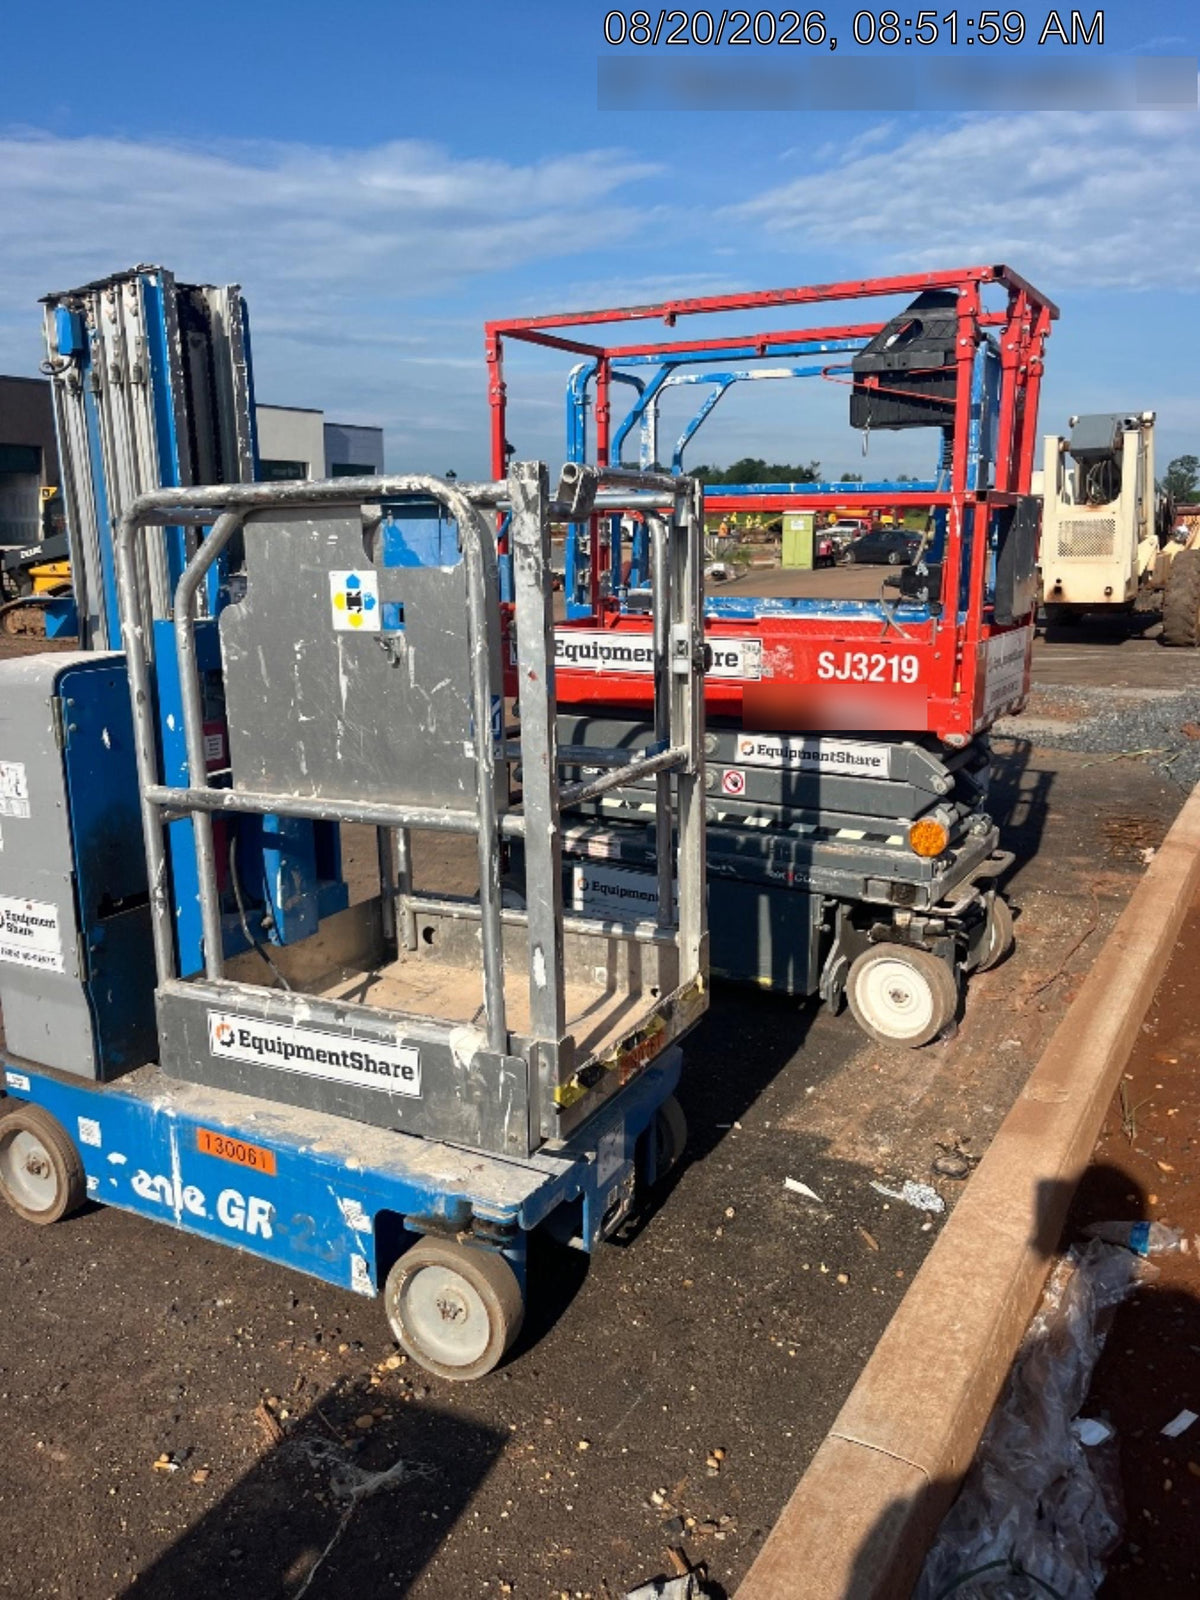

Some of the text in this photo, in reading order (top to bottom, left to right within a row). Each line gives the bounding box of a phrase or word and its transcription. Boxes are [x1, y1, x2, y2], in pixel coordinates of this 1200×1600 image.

[817, 651, 919, 683] SJ3219
[757, 744, 881, 767] EquipmentShare
[238, 1029, 415, 1081] EquipmentShare
[205, 1133, 267, 1169] 130061
